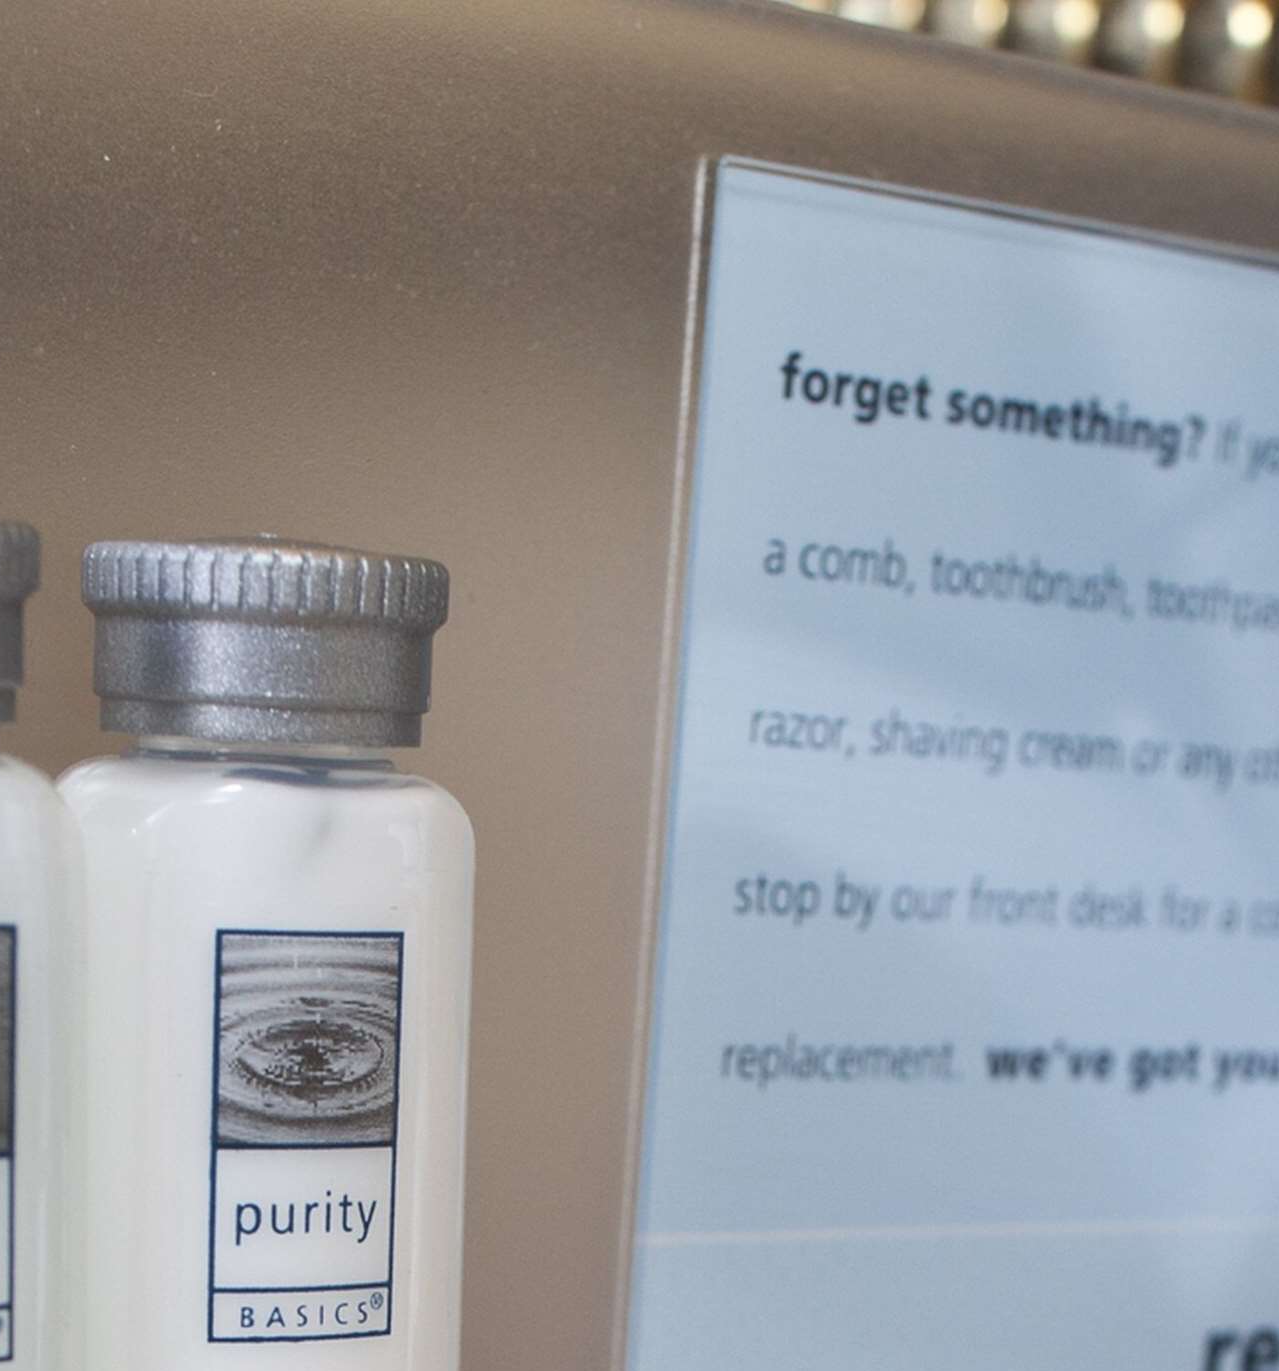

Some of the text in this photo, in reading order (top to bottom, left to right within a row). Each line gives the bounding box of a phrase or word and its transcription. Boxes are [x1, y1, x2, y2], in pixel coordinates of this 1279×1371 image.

[781, 351, 930, 424] forget
[946, 388, 1205, 468] something?
[763, 538, 787, 576] a
[798, 535, 917, 597] comb,
[931, 549, 1135, 619] toothbrush,
[749, 709, 856, 760] razor,
[867, 706, 1010, 778] shaving
[1018, 729, 1124, 773] cream
[1130, 739, 1169, 778] or
[1175, 742, 1233, 795] any
[733, 872, 821, 927] stop
[833, 868, 881, 932] by
[890, 882, 958, 923] our
[966, 873, 1061, 928] front
[1067, 880, 1146, 930] desk
[1160, 881, 1209, 932] for
[1221, 899, 1242, 936] a
[721, 1032, 963, 1091] replacement.
[986, 1035, 1116, 1081] we've
[1128, 1042, 1201, 1094] got
[234, 1189, 378, 1247] purity
